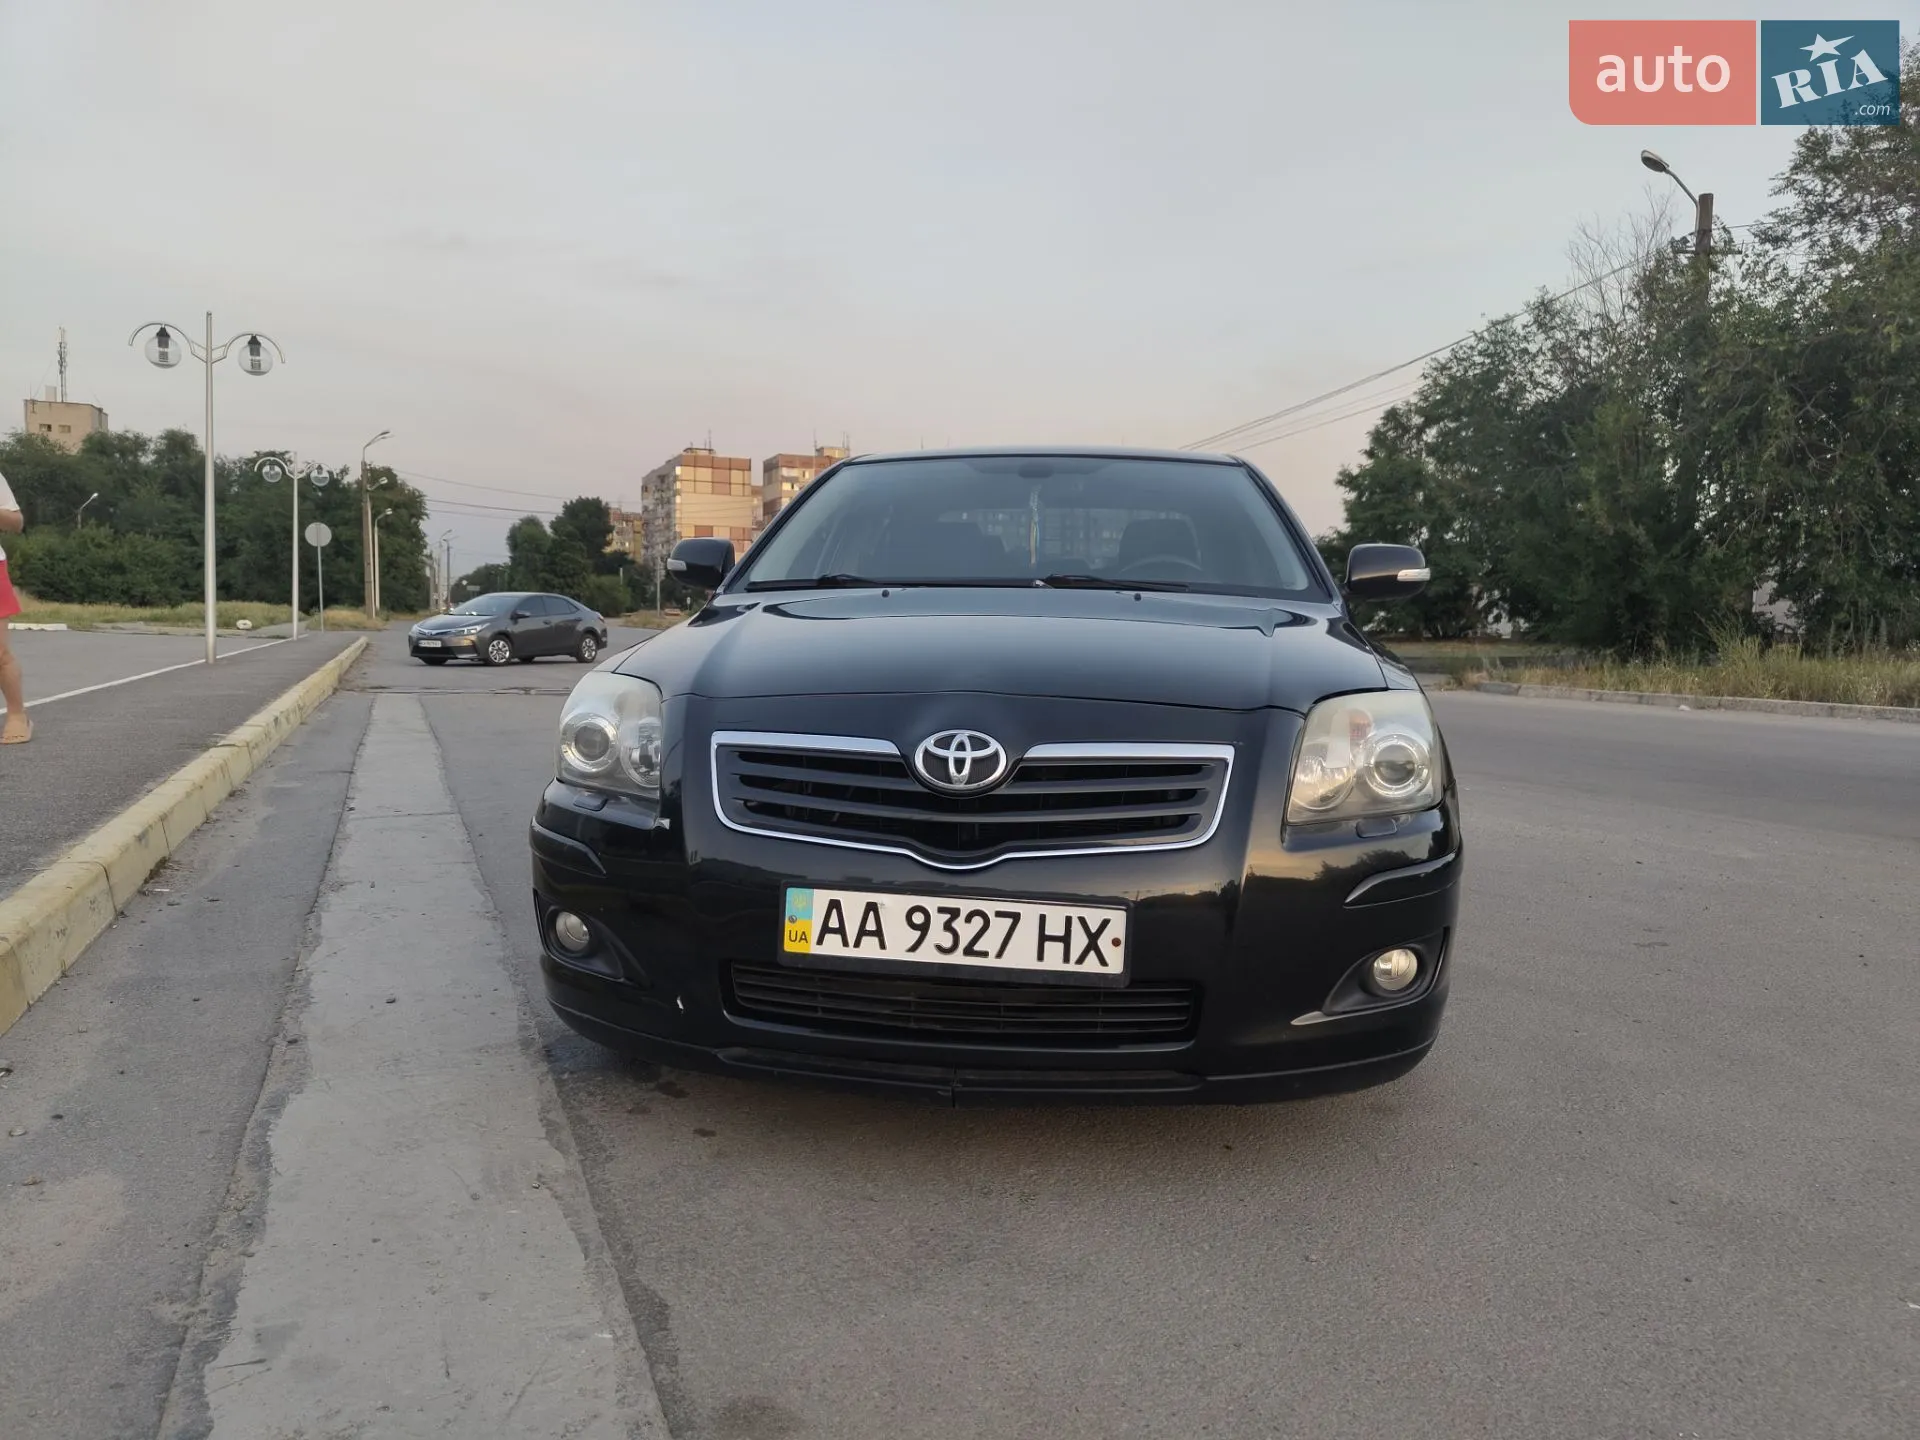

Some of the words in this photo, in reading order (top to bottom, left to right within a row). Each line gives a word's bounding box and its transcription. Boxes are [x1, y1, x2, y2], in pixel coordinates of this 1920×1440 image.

[788, 929, 809, 944] UA
[815, 898, 887, 951] AA
[904, 904, 1022, 959] 9327
[1036, 913, 1112, 967] HX
